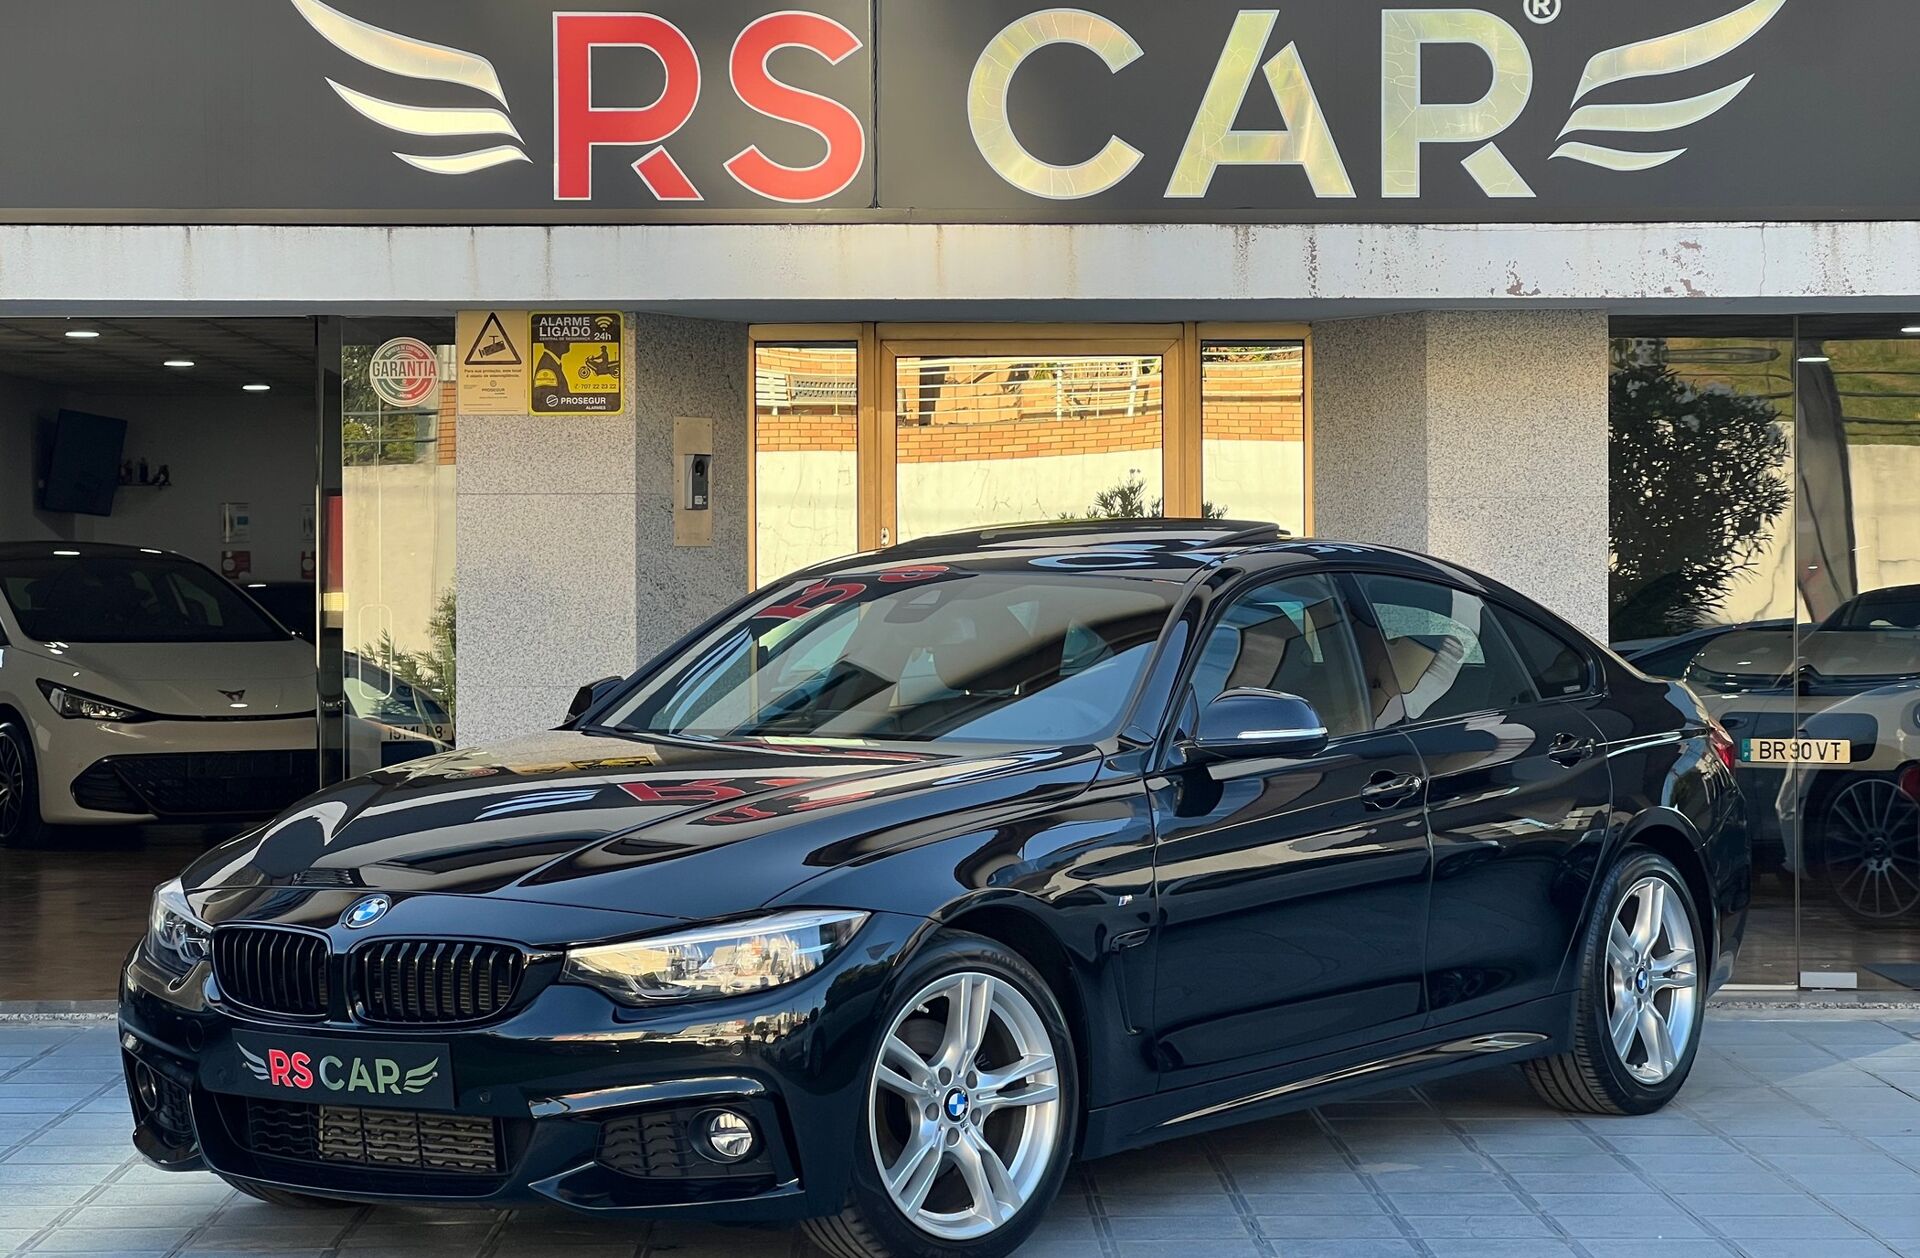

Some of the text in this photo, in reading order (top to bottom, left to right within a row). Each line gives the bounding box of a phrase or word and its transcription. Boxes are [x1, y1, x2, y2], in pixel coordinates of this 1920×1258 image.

[553, 8, 1537, 203] RS CAR
[540, 316, 590, 326] ALARME
[539, 327, 591, 337] LIGADO
[594, 332, 612, 341] 24h
[372, 361, 437, 377] GARANTIA
[560, 397, 607, 405] PROSEGUR
[1760, 741, 1840, 760] BR 90 VT
[269, 1049, 402, 1095] RS CAR
